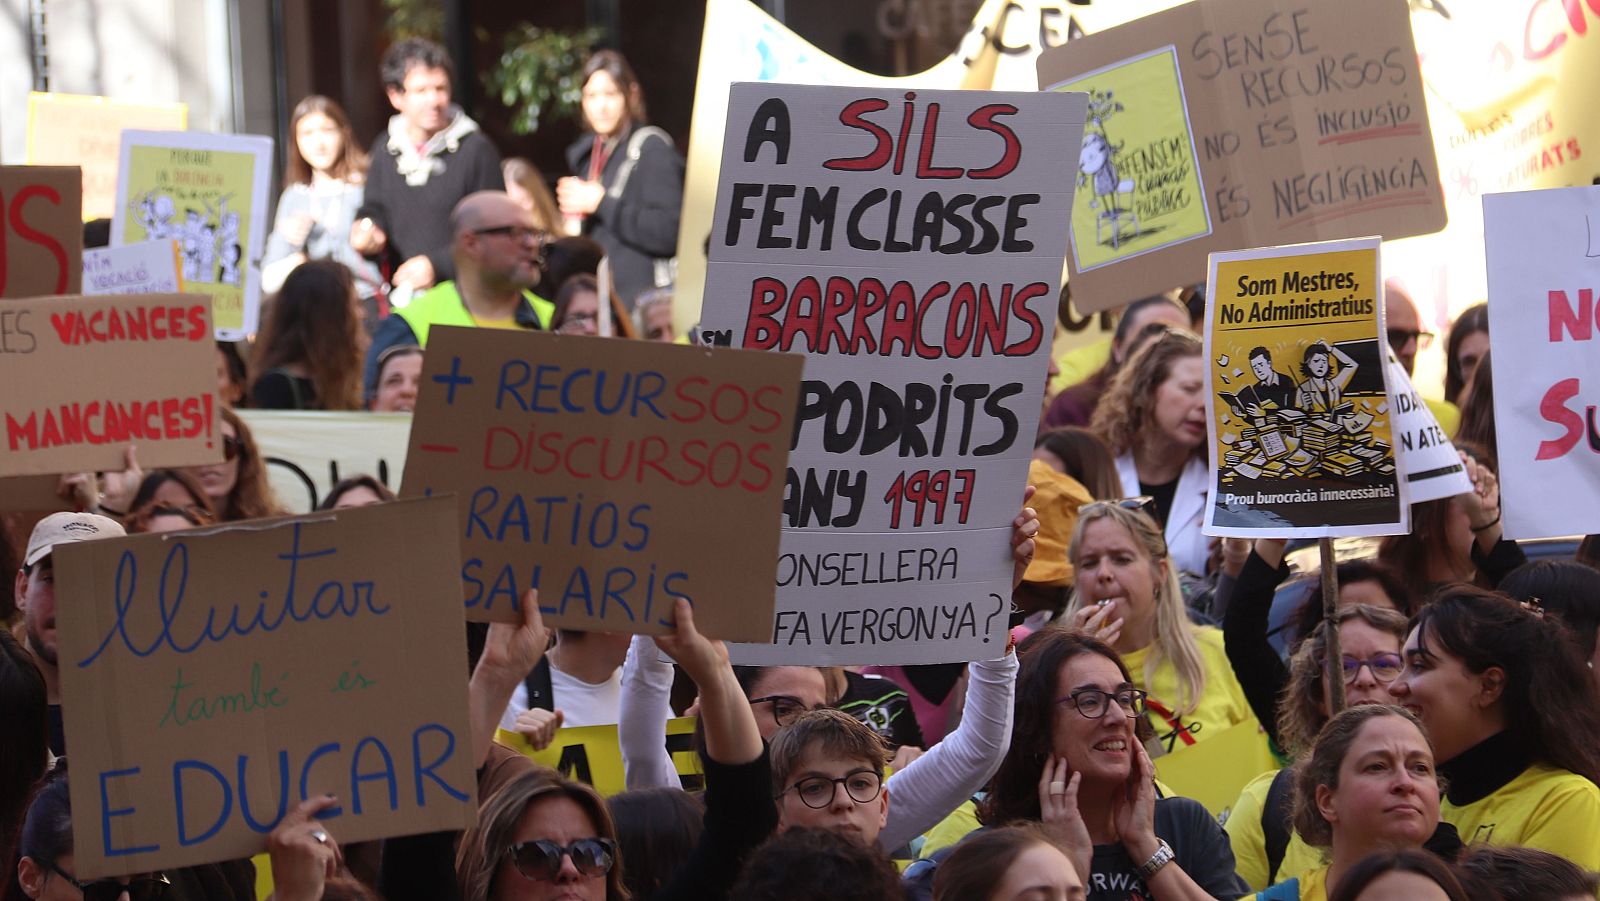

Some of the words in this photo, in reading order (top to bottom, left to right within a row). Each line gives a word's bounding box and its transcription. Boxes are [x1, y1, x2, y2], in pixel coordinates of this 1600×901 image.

[1192, 9, 1318, 81] SENSE
[1241, 47, 1406, 108] RECURSOS
[743, 98, 791, 164] A
[823, 91, 1021, 179] SILS
[1204, 131, 1240, 161] NO
[1258, 113, 1297, 148] ÉS
[725, 183, 839, 251] FEM
[846, 187, 1041, 254] CLASSE
[1216, 176, 1250, 223] ÉS
[1220, 303, 1245, 325] No
[1248, 295, 1374, 323] Administratius
[1236, 275, 1277, 298] Som
[1282, 271, 1360, 294] Mestres,
[51, 305, 207, 345] VACANCES
[742, 275, 1049, 359] BARRACONS
[1547, 288, 1600, 343] N
[5, 393, 213, 451] MANCANCES!
[496, 358, 783, 434] RECURSOS
[884, 468, 976, 529] 1997
[1225, 491, 1255, 505] Prou
[1256, 488, 1318, 504] burocràcia
[1319, 483, 1395, 502] innecessària!
[821, 592, 1003, 645] VERGONYA?
[159, 661, 290, 728] també
[100, 723, 471, 857] EDUCAR
